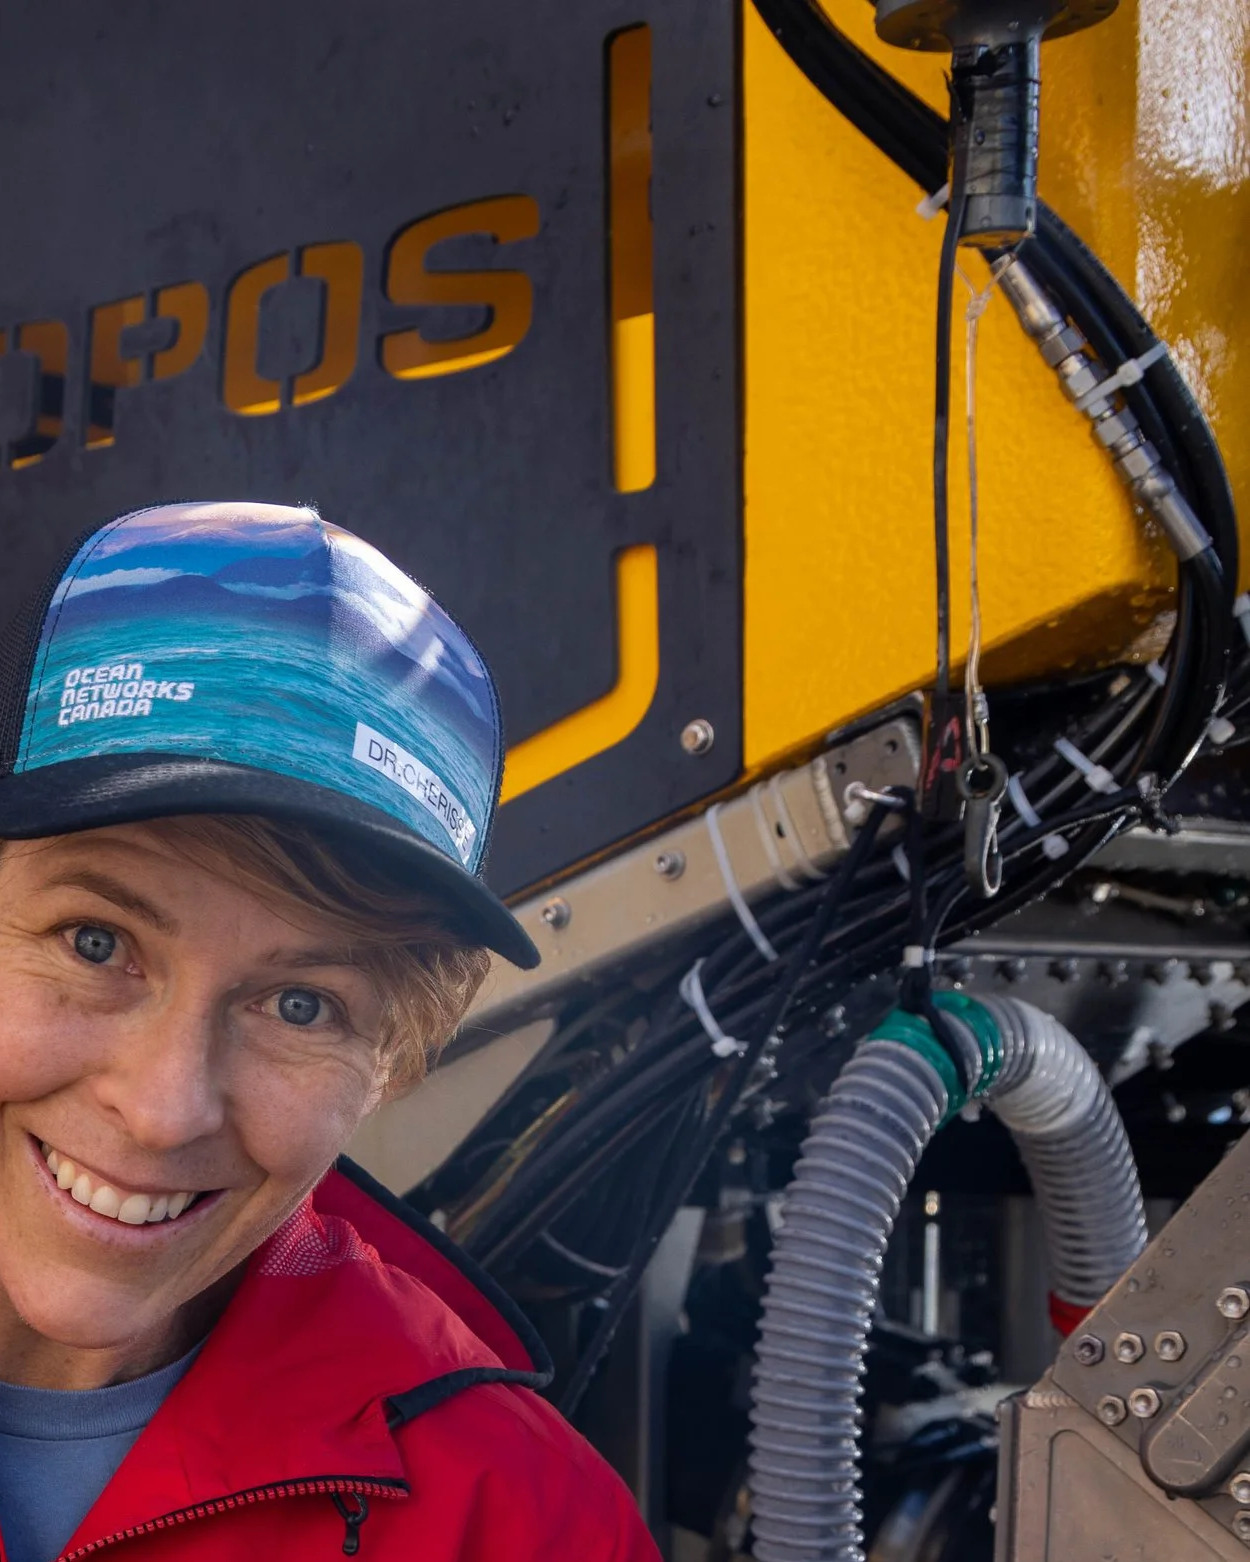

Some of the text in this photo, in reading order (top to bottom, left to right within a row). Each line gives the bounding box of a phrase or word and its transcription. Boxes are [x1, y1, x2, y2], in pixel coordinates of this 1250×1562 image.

[64, 662, 144, 689] OCEAN
[60, 679, 195, 708] NETWORKS
[57, 697, 153, 727] CANADA
